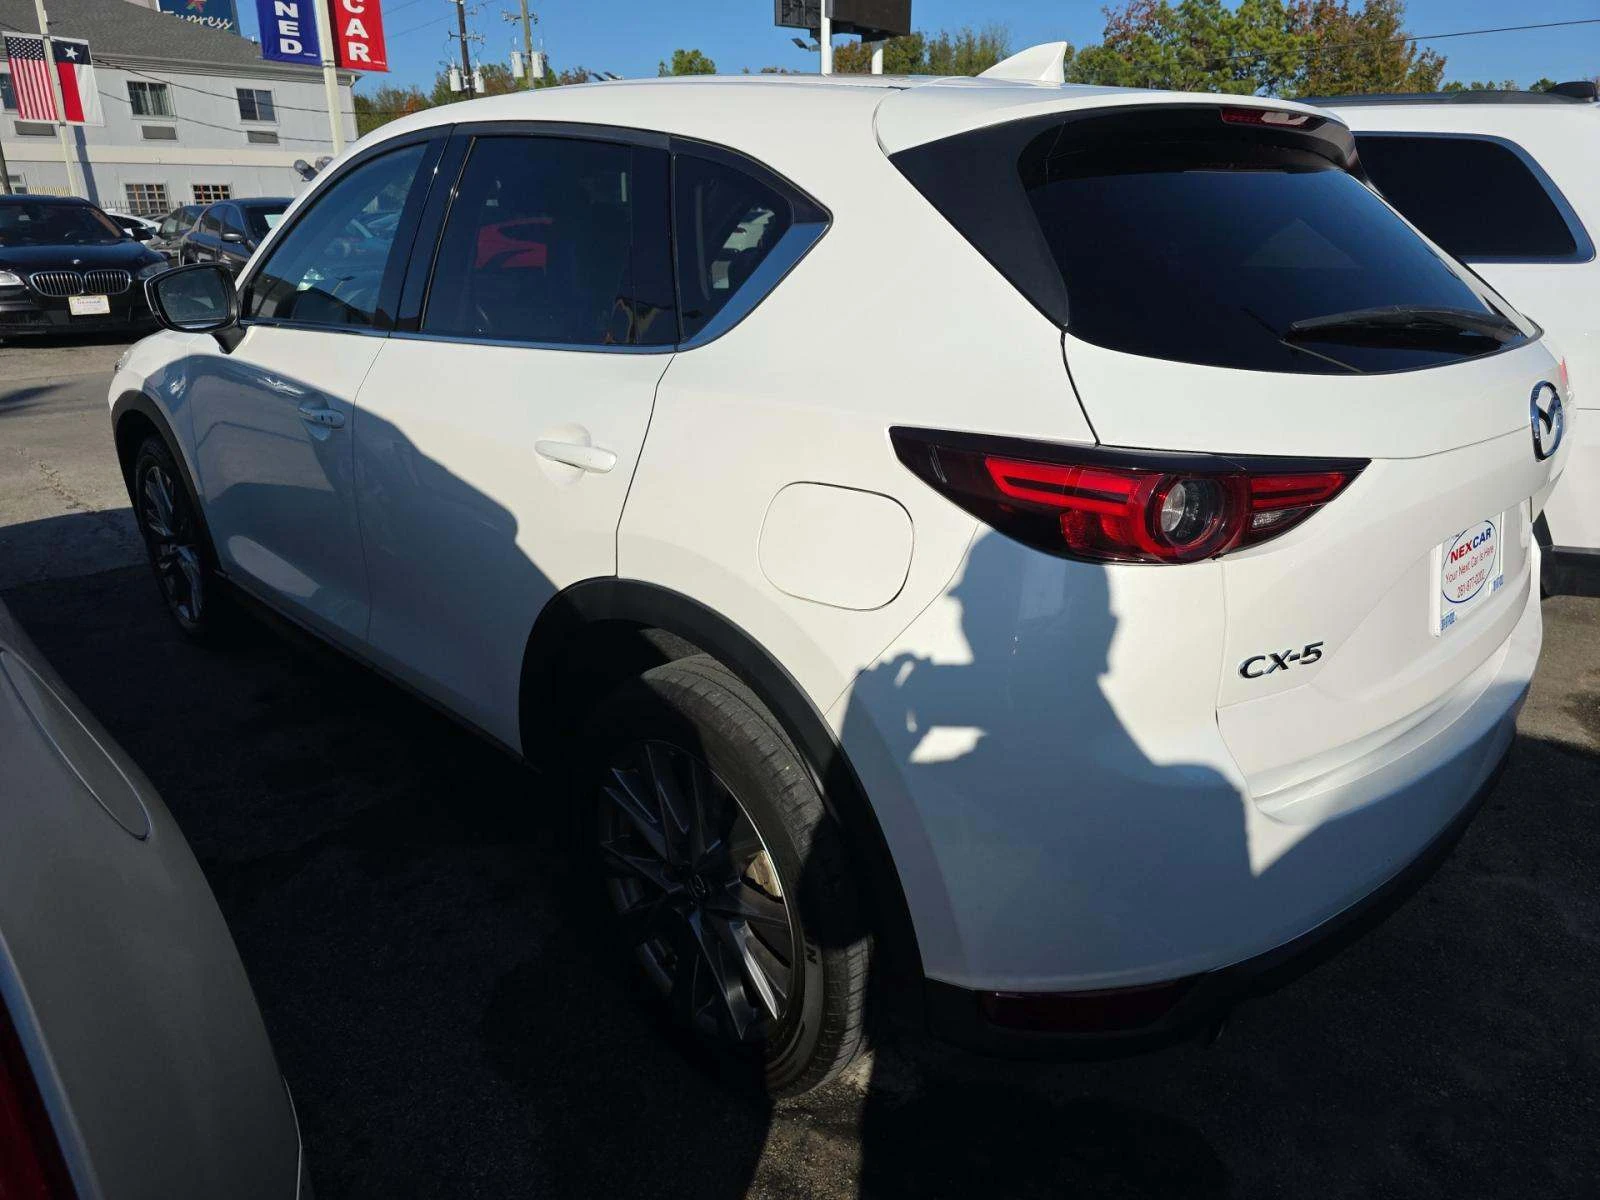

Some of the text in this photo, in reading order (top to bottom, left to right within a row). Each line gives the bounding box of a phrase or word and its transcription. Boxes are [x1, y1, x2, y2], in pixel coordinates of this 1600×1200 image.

[1450, 527, 1492, 564] NEXCAR
[1445, 569, 1459, 585] Your
[1458, 560, 1470, 577] Next
[1238, 641, 1324, 679] CX-5
